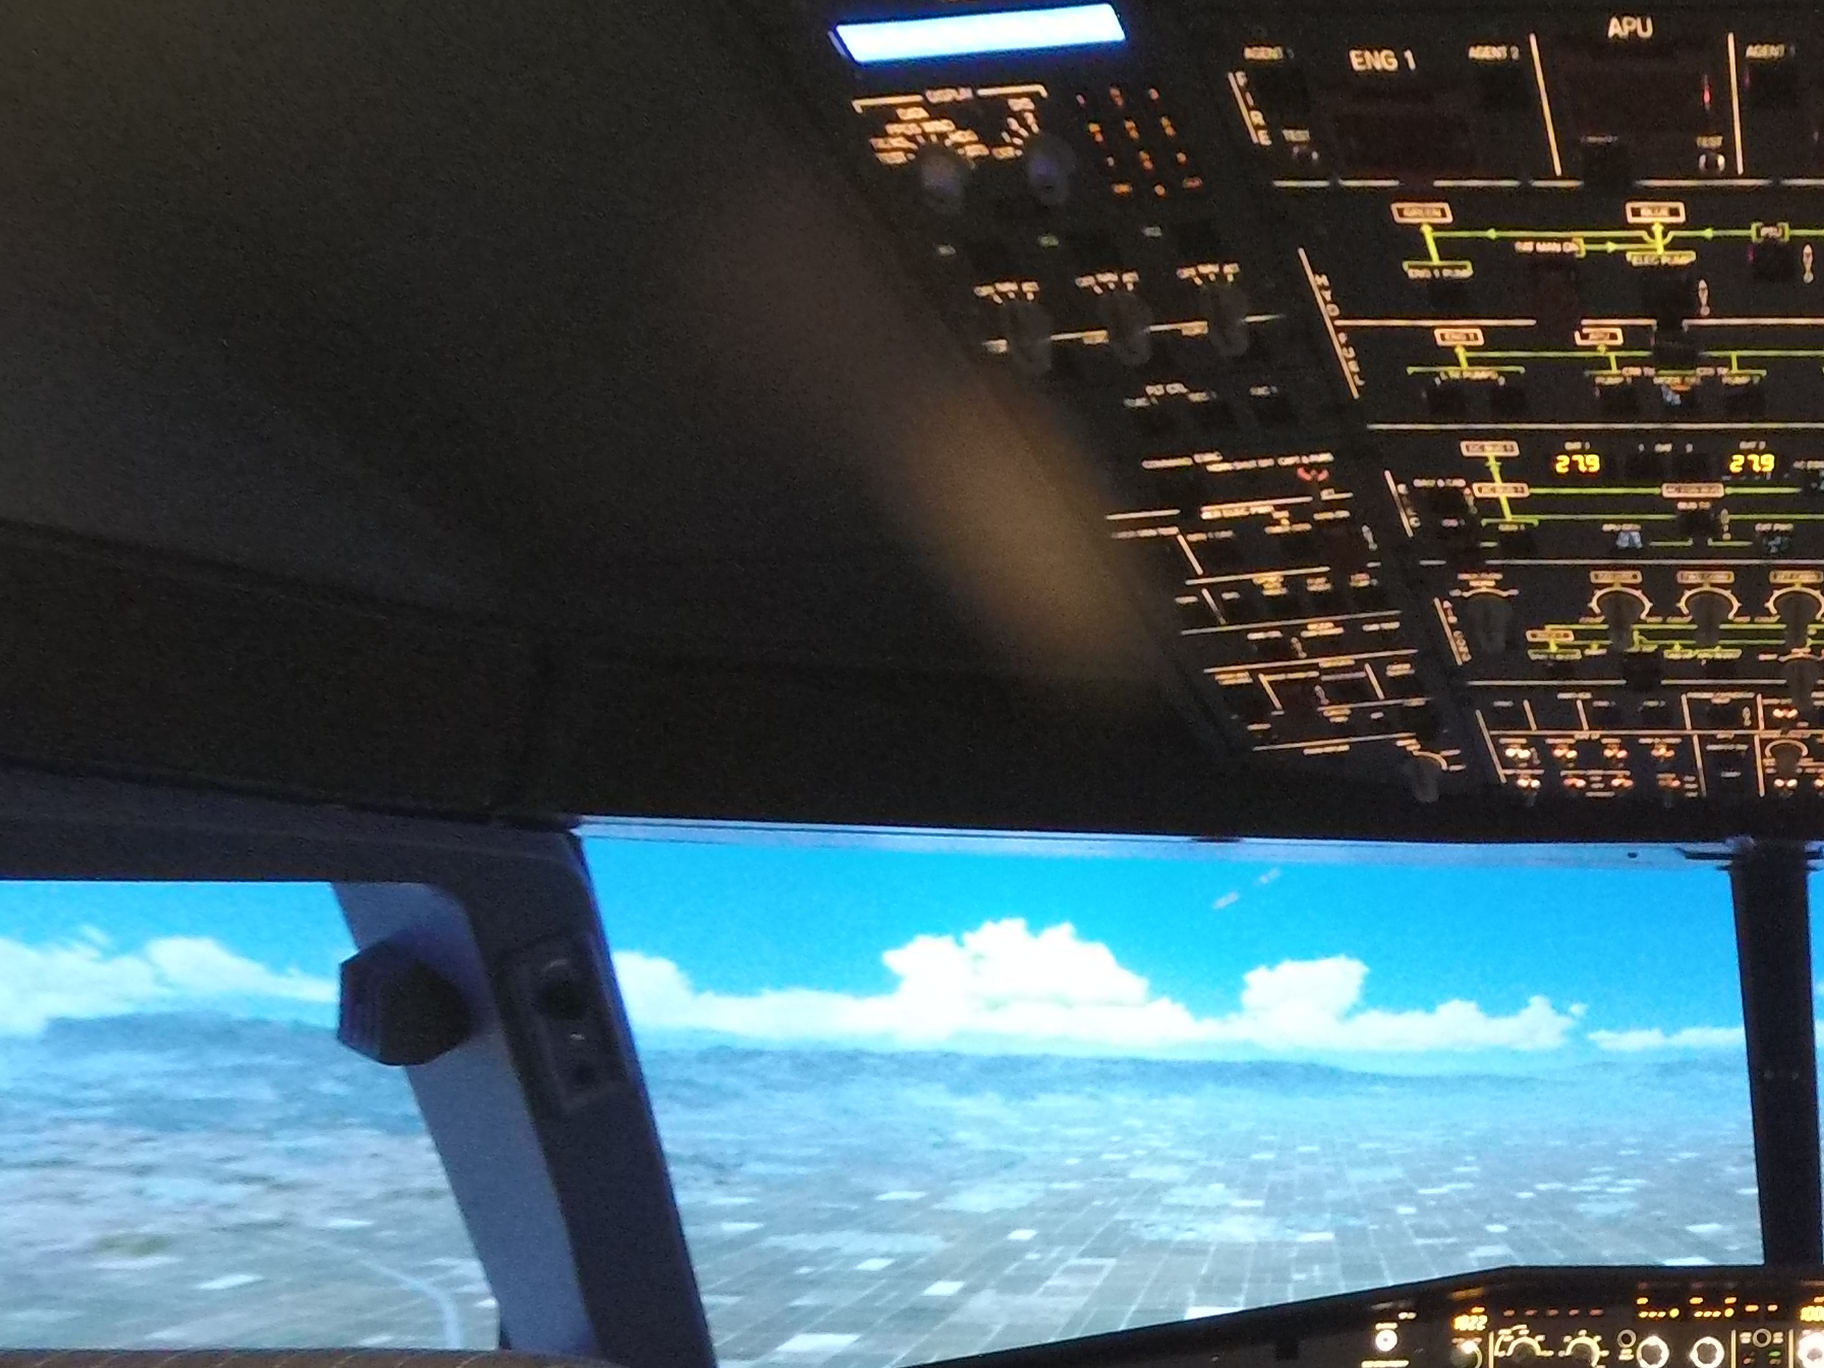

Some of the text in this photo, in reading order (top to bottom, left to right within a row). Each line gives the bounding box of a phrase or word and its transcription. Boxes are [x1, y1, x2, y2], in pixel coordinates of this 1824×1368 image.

[1607, 17, 1653, 38] APU
[1349, 49, 1416, 72] ENG 1
